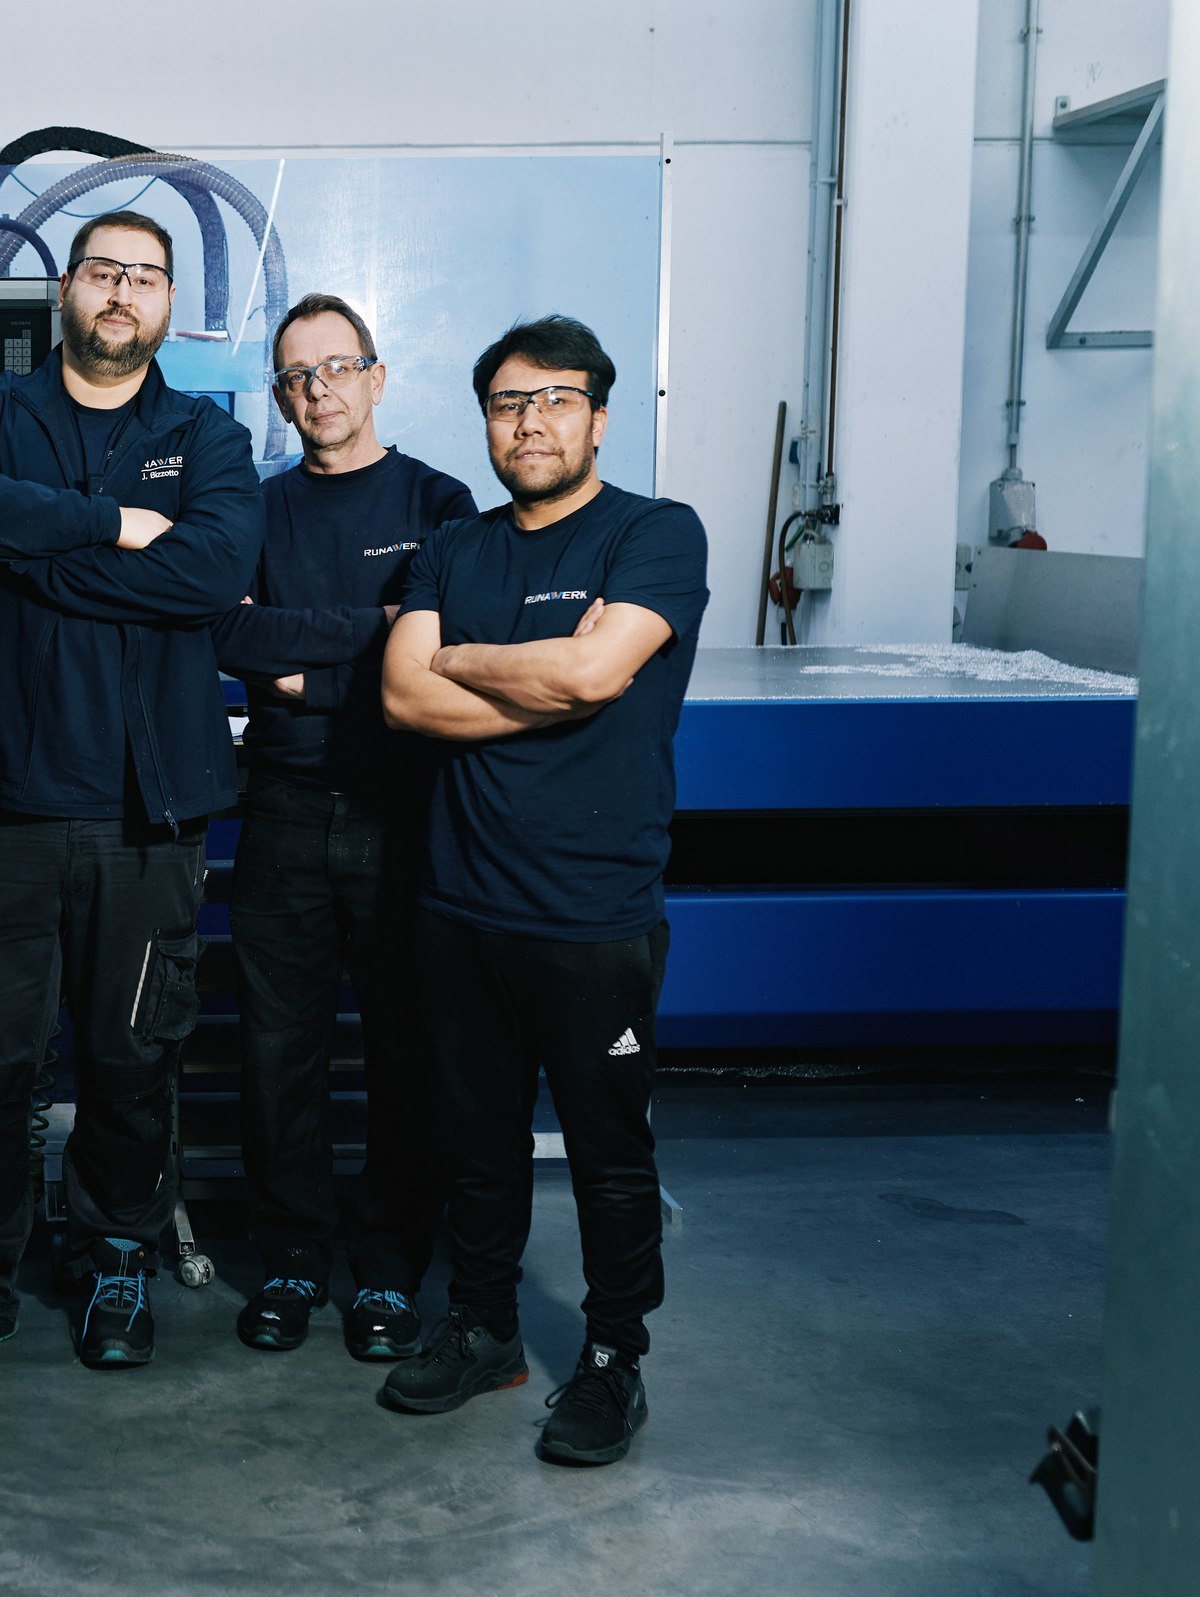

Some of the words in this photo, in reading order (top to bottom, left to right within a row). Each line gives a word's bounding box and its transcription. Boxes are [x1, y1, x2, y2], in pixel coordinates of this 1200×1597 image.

[150, 470, 179, 479] Bizzotto
[524, 590, 588, 604] RUNAWERK
[608, 1044, 640, 1056] adidas
